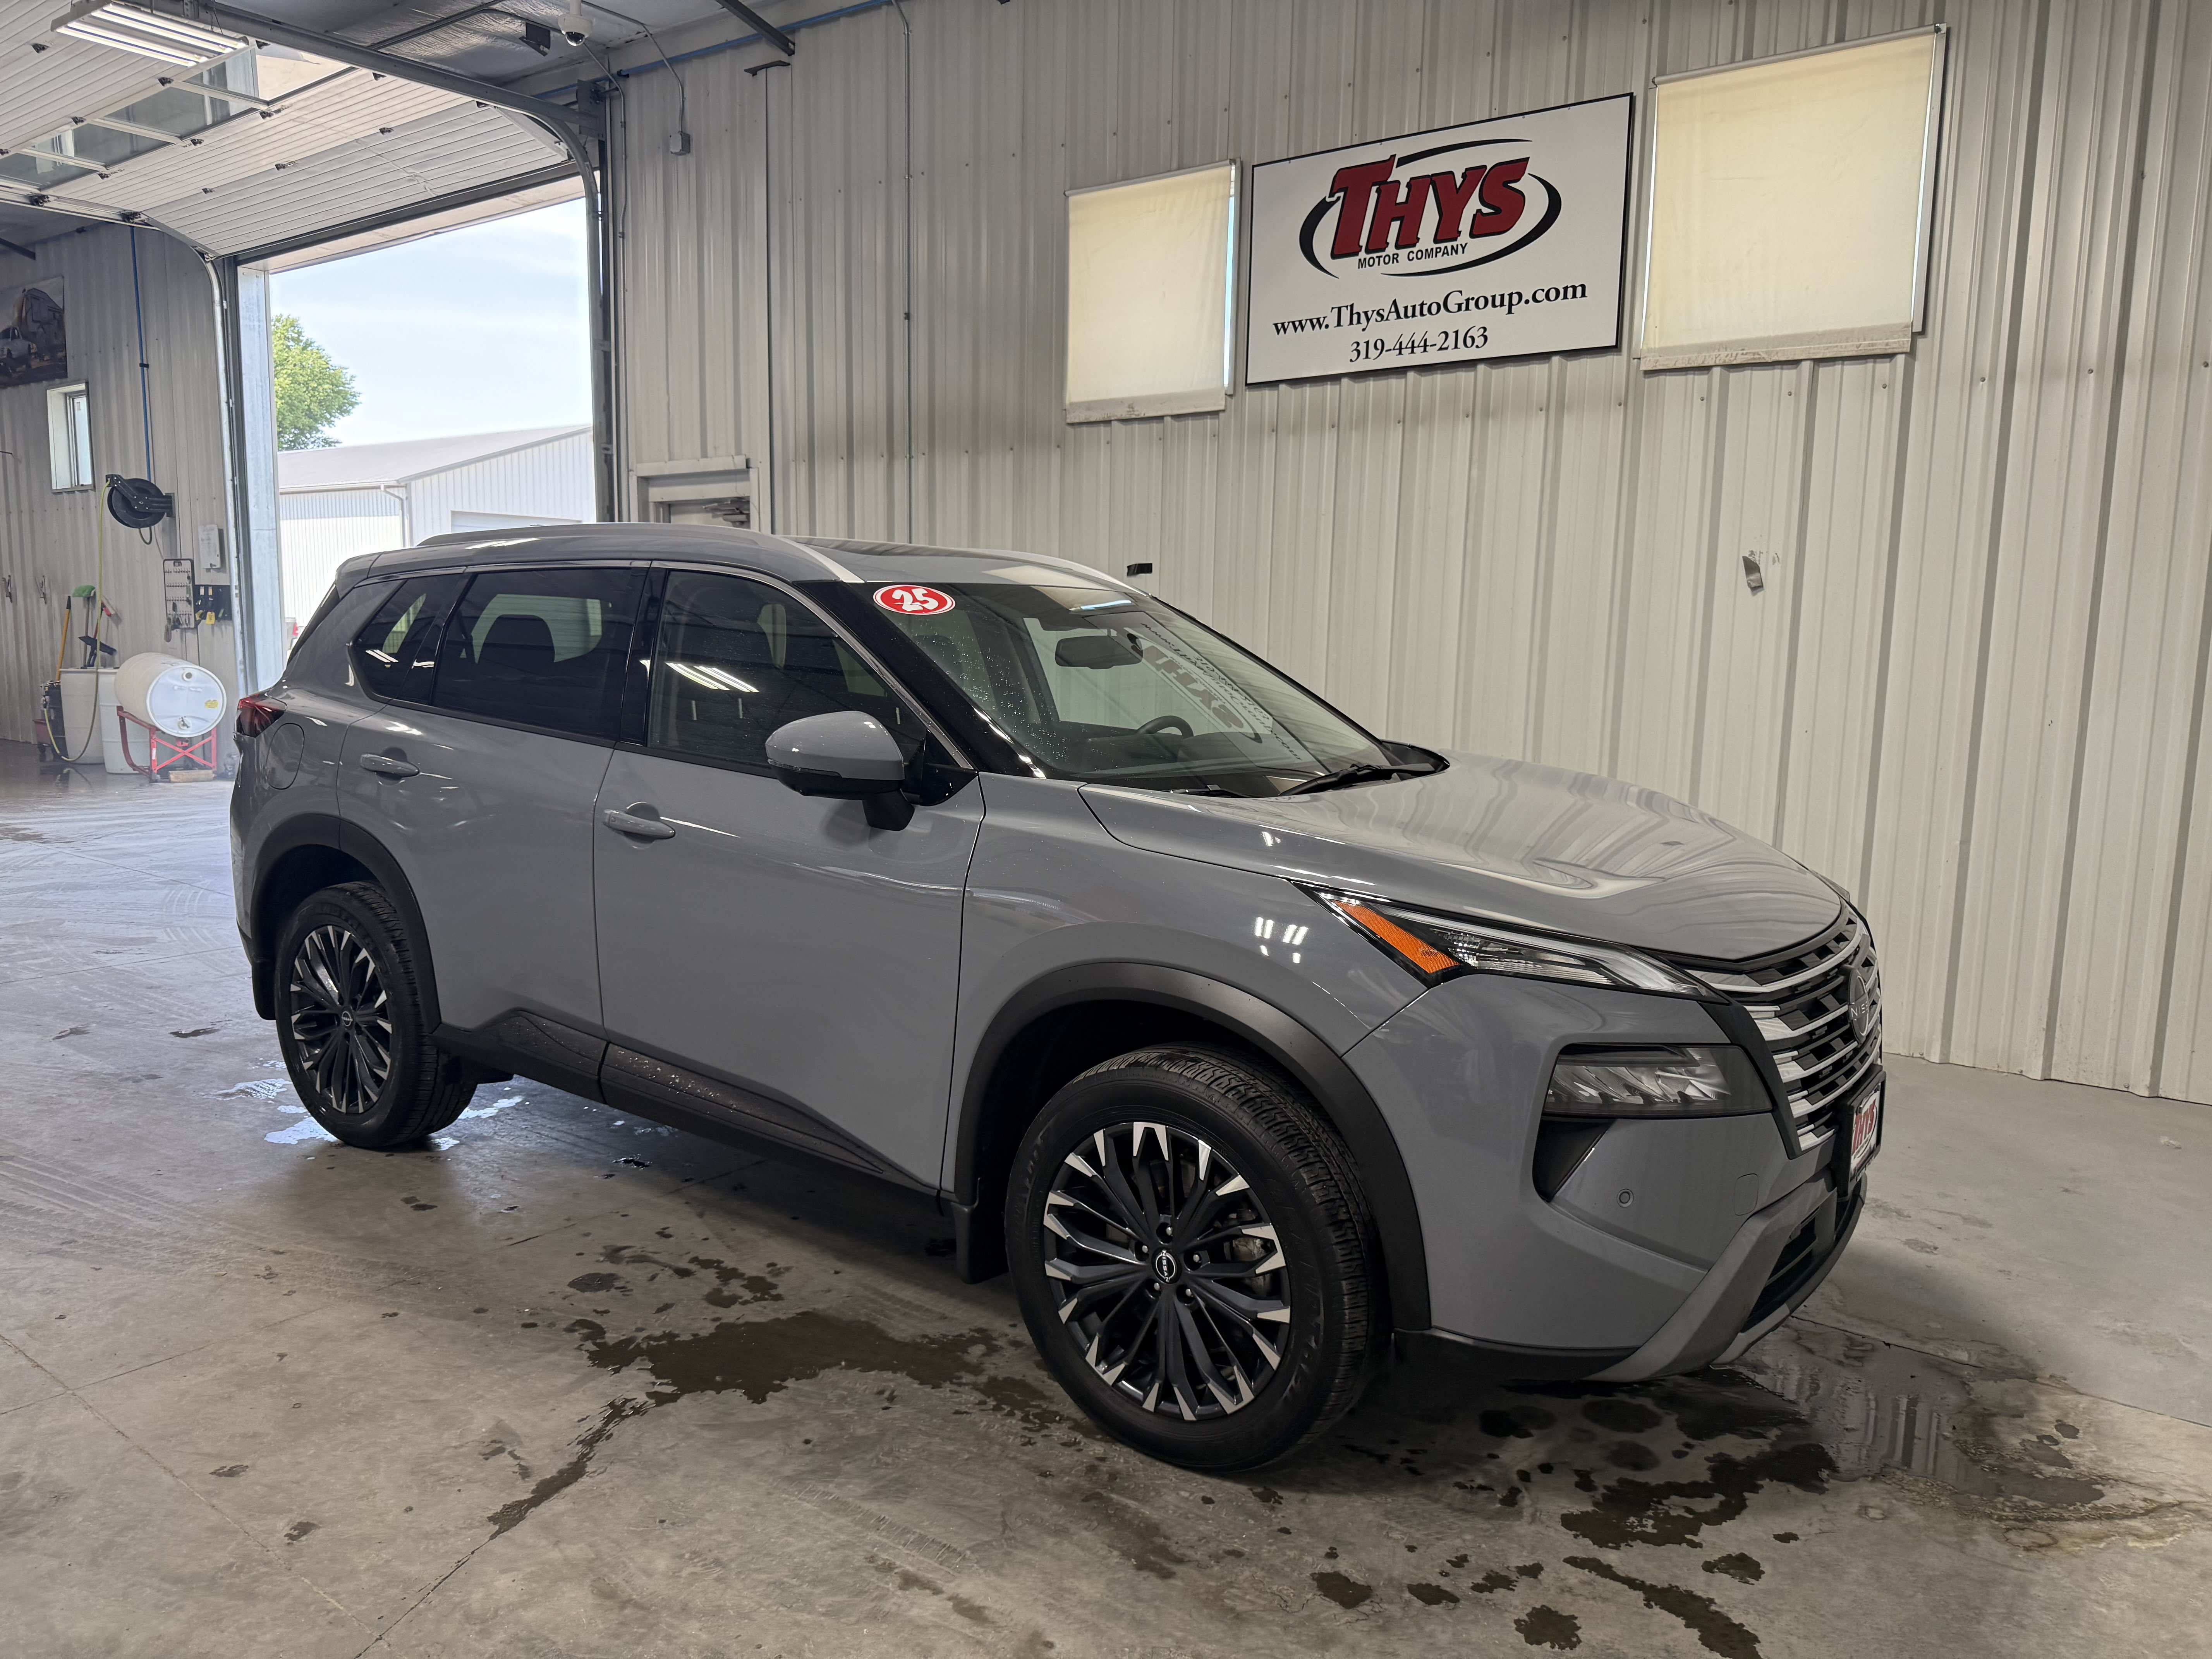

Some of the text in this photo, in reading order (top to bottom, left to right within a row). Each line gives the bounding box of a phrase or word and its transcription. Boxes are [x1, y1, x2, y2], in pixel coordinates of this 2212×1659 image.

[1329, 154, 1530, 260] THYS
[1358, 243, 1468, 269] MOTOR COMPANY
[1273, 283, 1587, 335] www.ThysAutoGroup.com
[1350, 326, 1488, 362] 319-444-2163
[892, 588, 939, 611] 25
